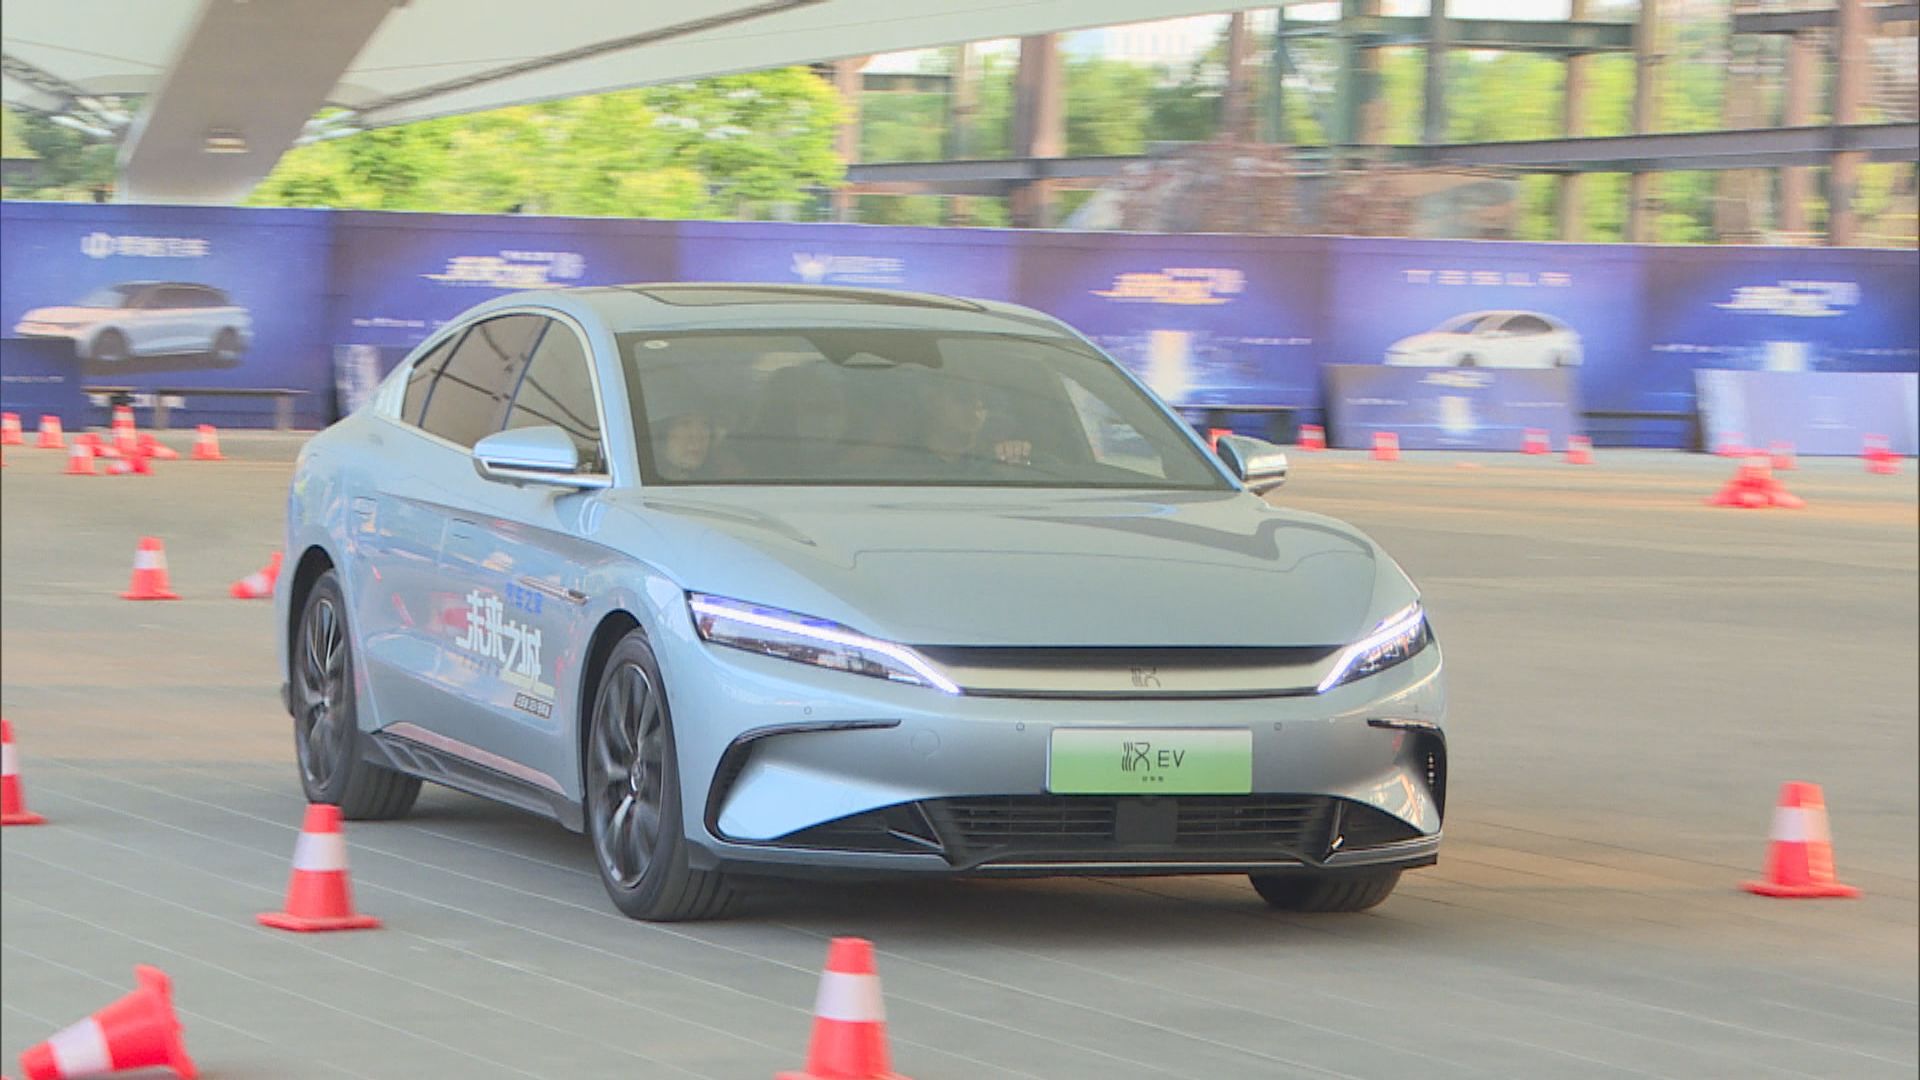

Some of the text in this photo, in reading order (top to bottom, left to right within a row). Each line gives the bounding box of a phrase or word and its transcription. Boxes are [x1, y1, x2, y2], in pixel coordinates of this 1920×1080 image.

[455, 589, 542, 683] 未来之城
[1157, 750, 1186, 768] EV
